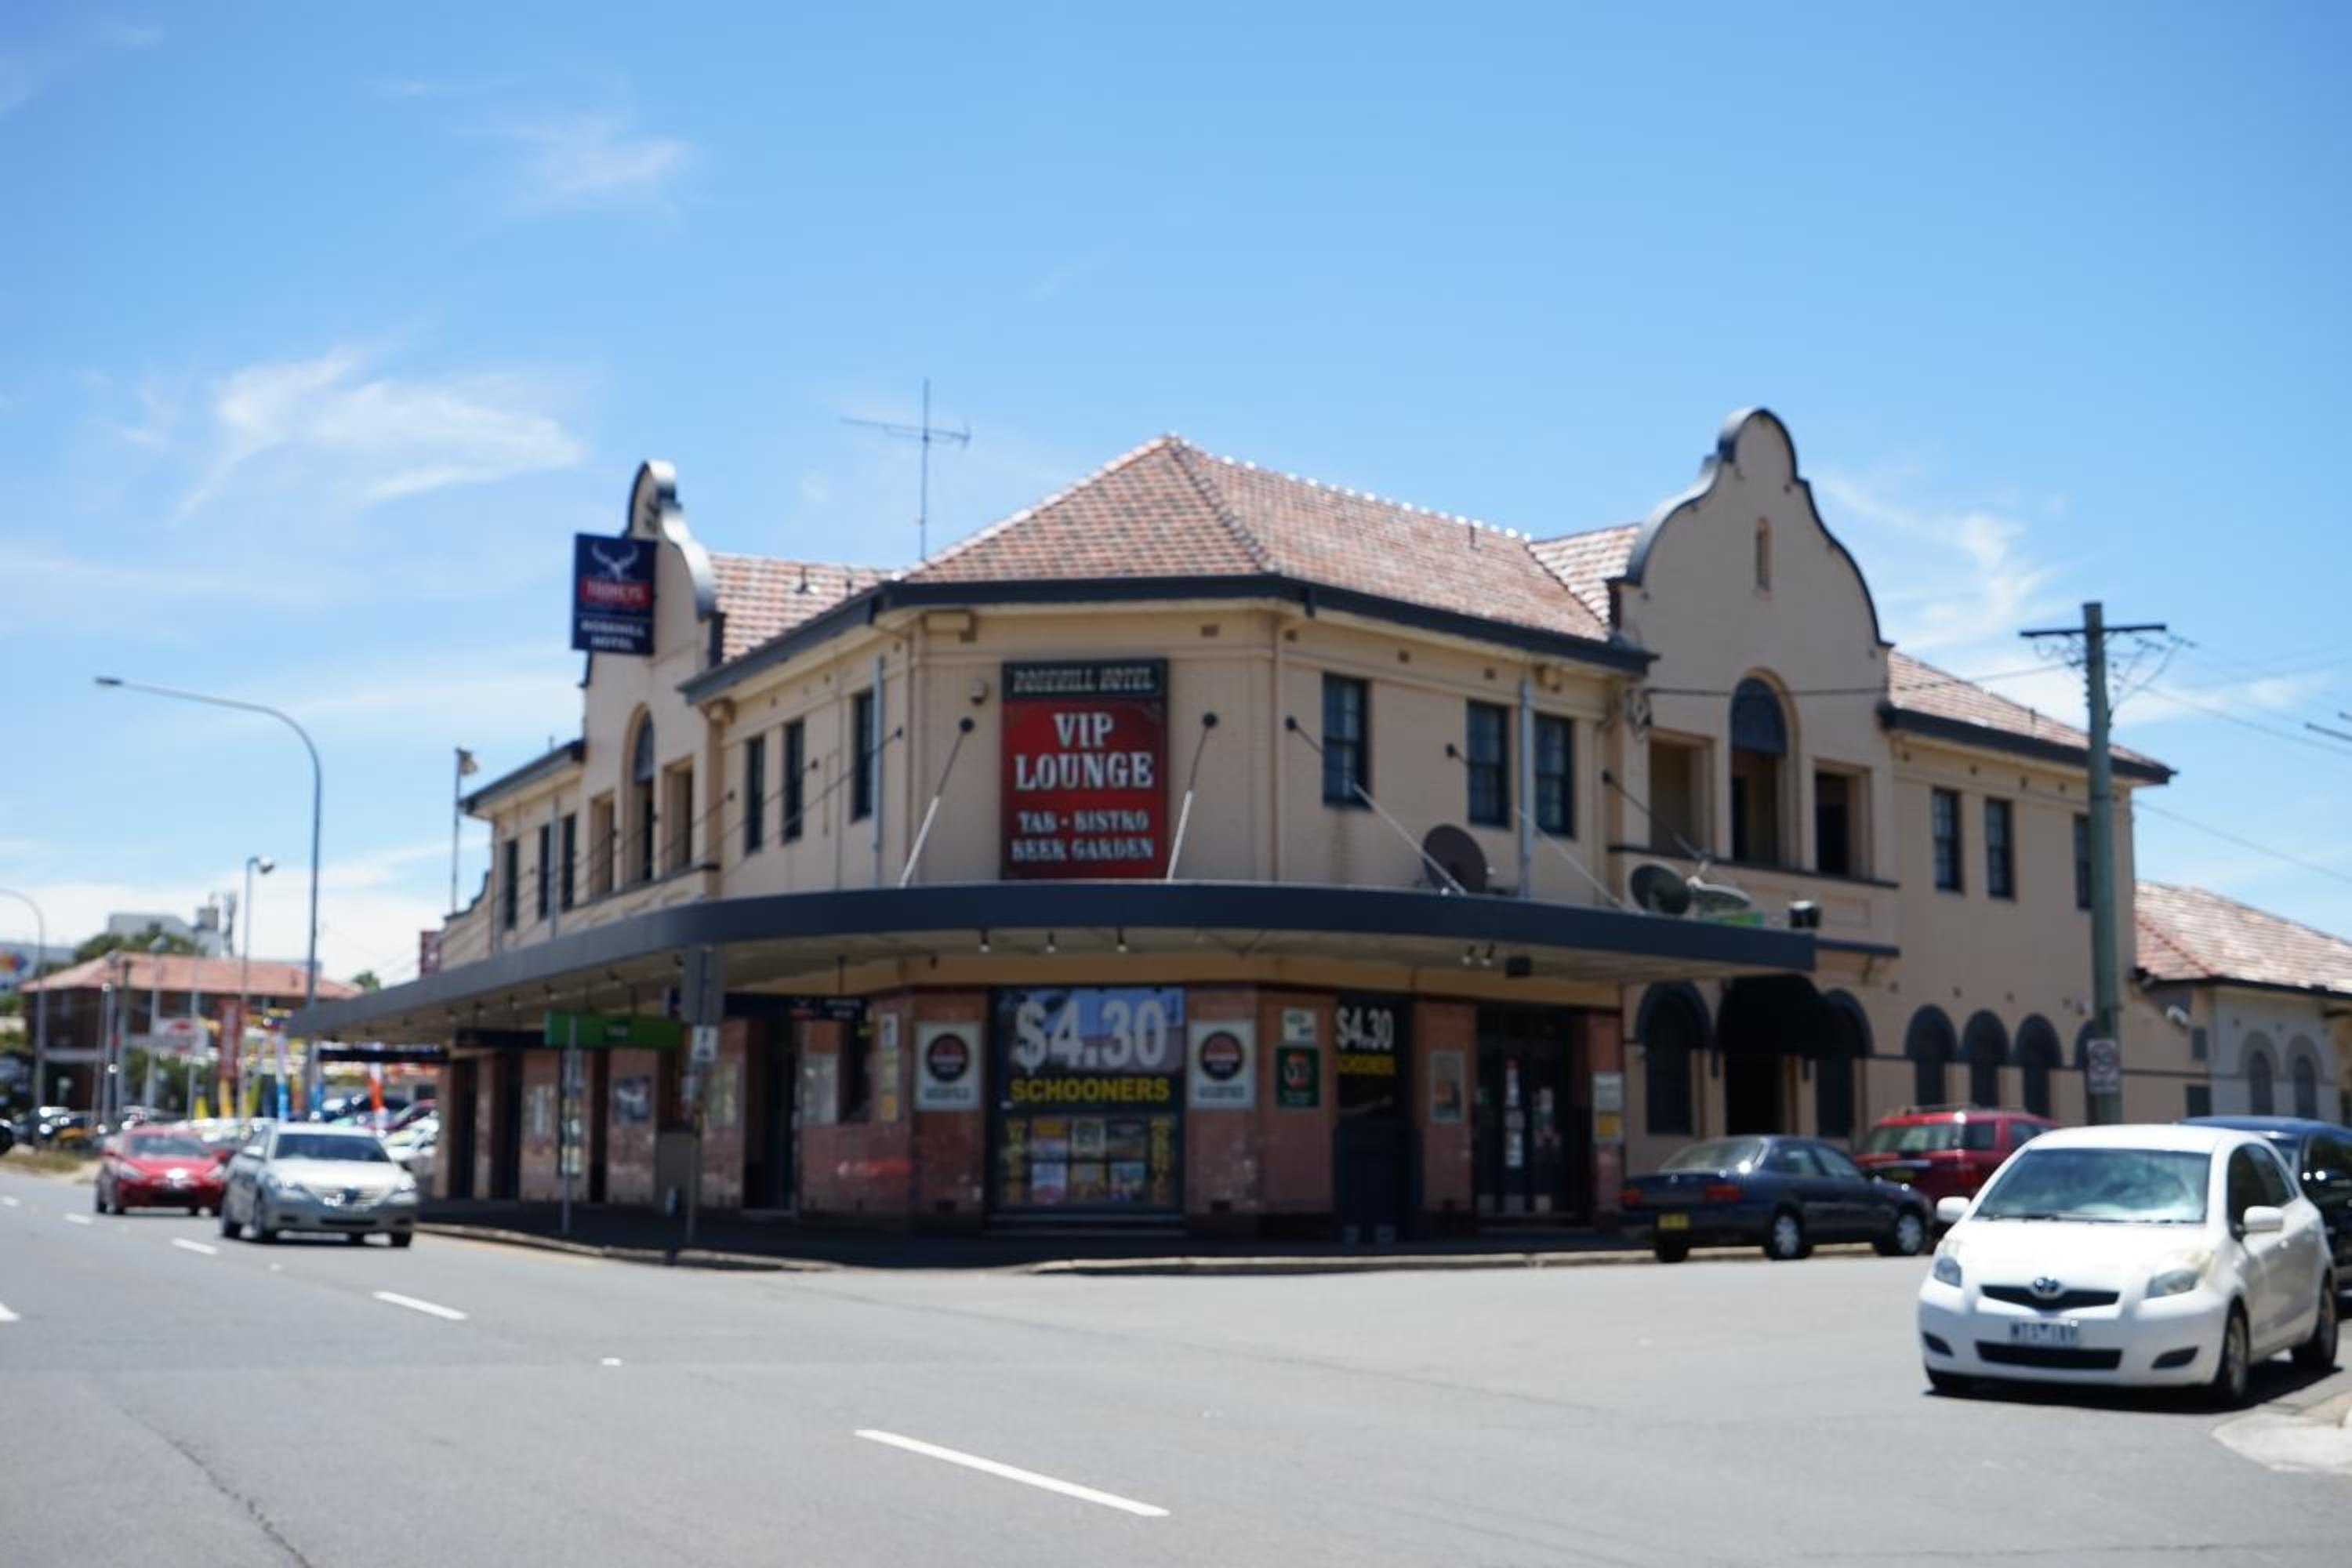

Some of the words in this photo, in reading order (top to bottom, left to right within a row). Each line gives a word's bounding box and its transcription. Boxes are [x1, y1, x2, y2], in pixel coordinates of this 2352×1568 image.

[1053, 711, 1114, 748] VIP
[1014, 751, 1155, 790] LOUNGE
[1018, 810, 1056, 834] TAB
[1074, 808, 1149, 833] BISTRO
[1011, 838, 1067, 862] BEER
[1071, 836, 1155, 860] GARDEN
[1011, 998, 1167, 1075] $4.30
[1335, 1006, 1395, 1051] $4.30
[1010, 1076, 1170, 1103] SCHOONERS
